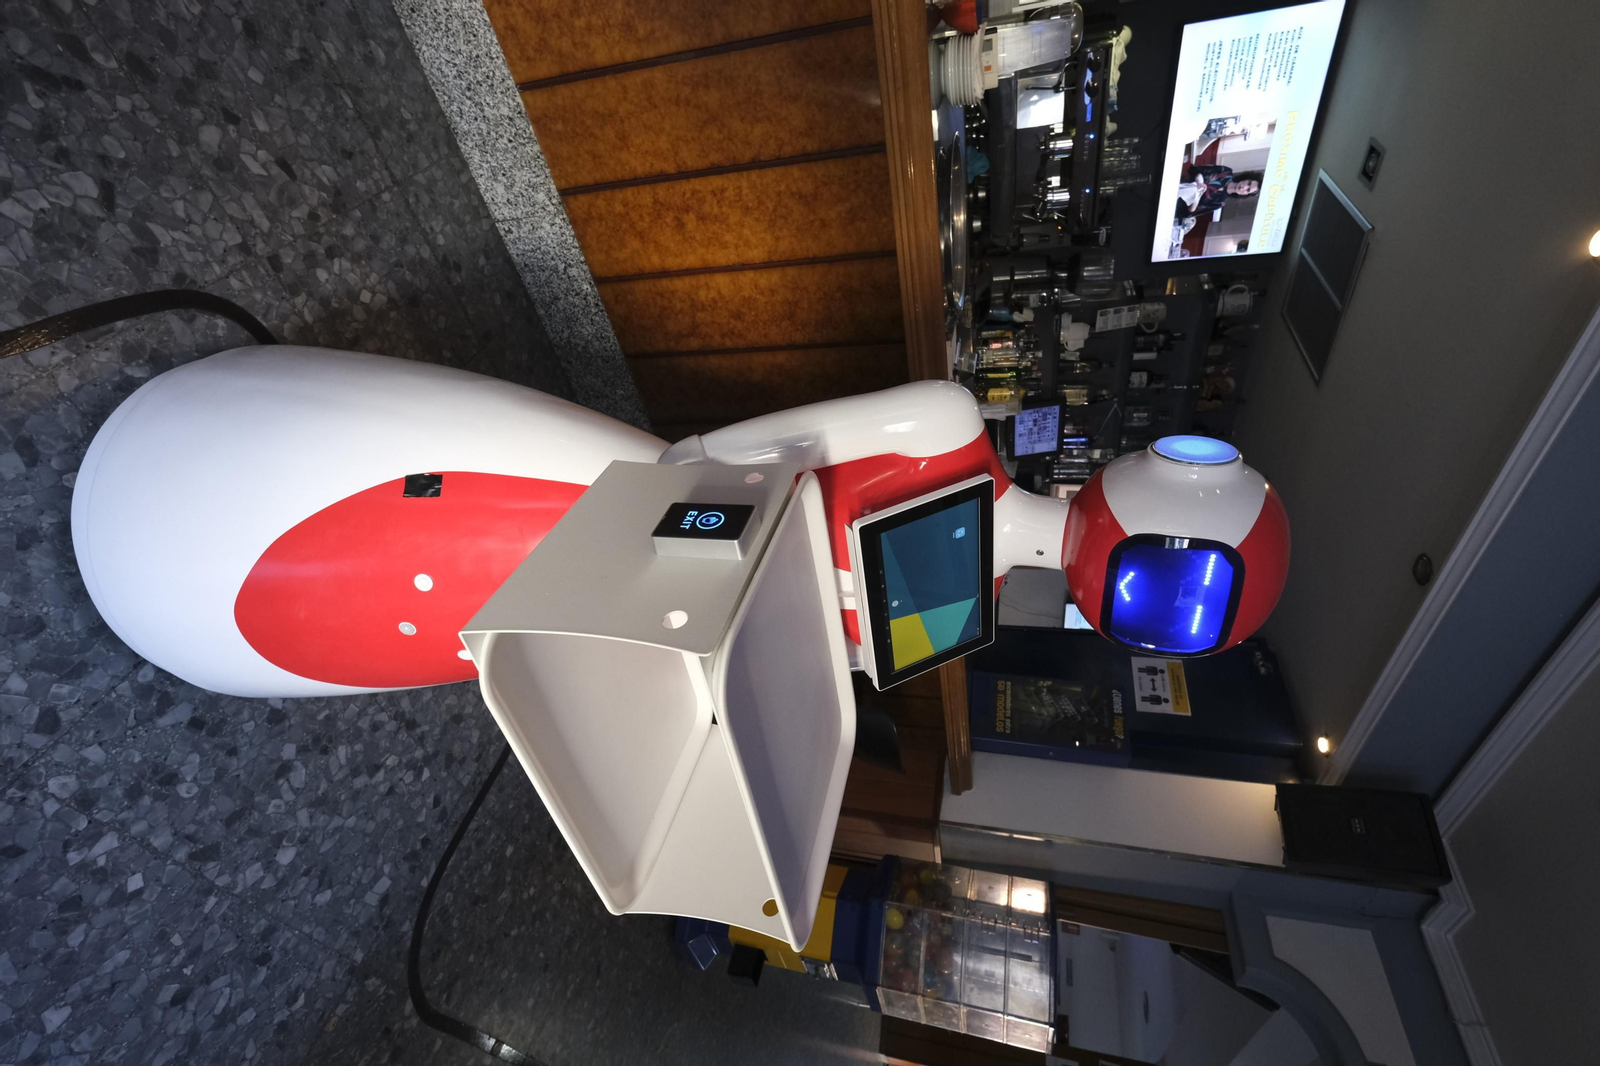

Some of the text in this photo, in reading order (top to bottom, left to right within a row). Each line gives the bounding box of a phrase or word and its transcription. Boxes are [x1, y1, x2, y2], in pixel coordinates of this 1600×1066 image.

[1294, 45, 1300, 54] DE
[1274, 110, 1299, 180] PRÓXIMO
[1258, 184, 1281, 249] CAPÍTULO
[680, 510, 698, 530] EXIT
[996, 694, 1005, 733] modelos
